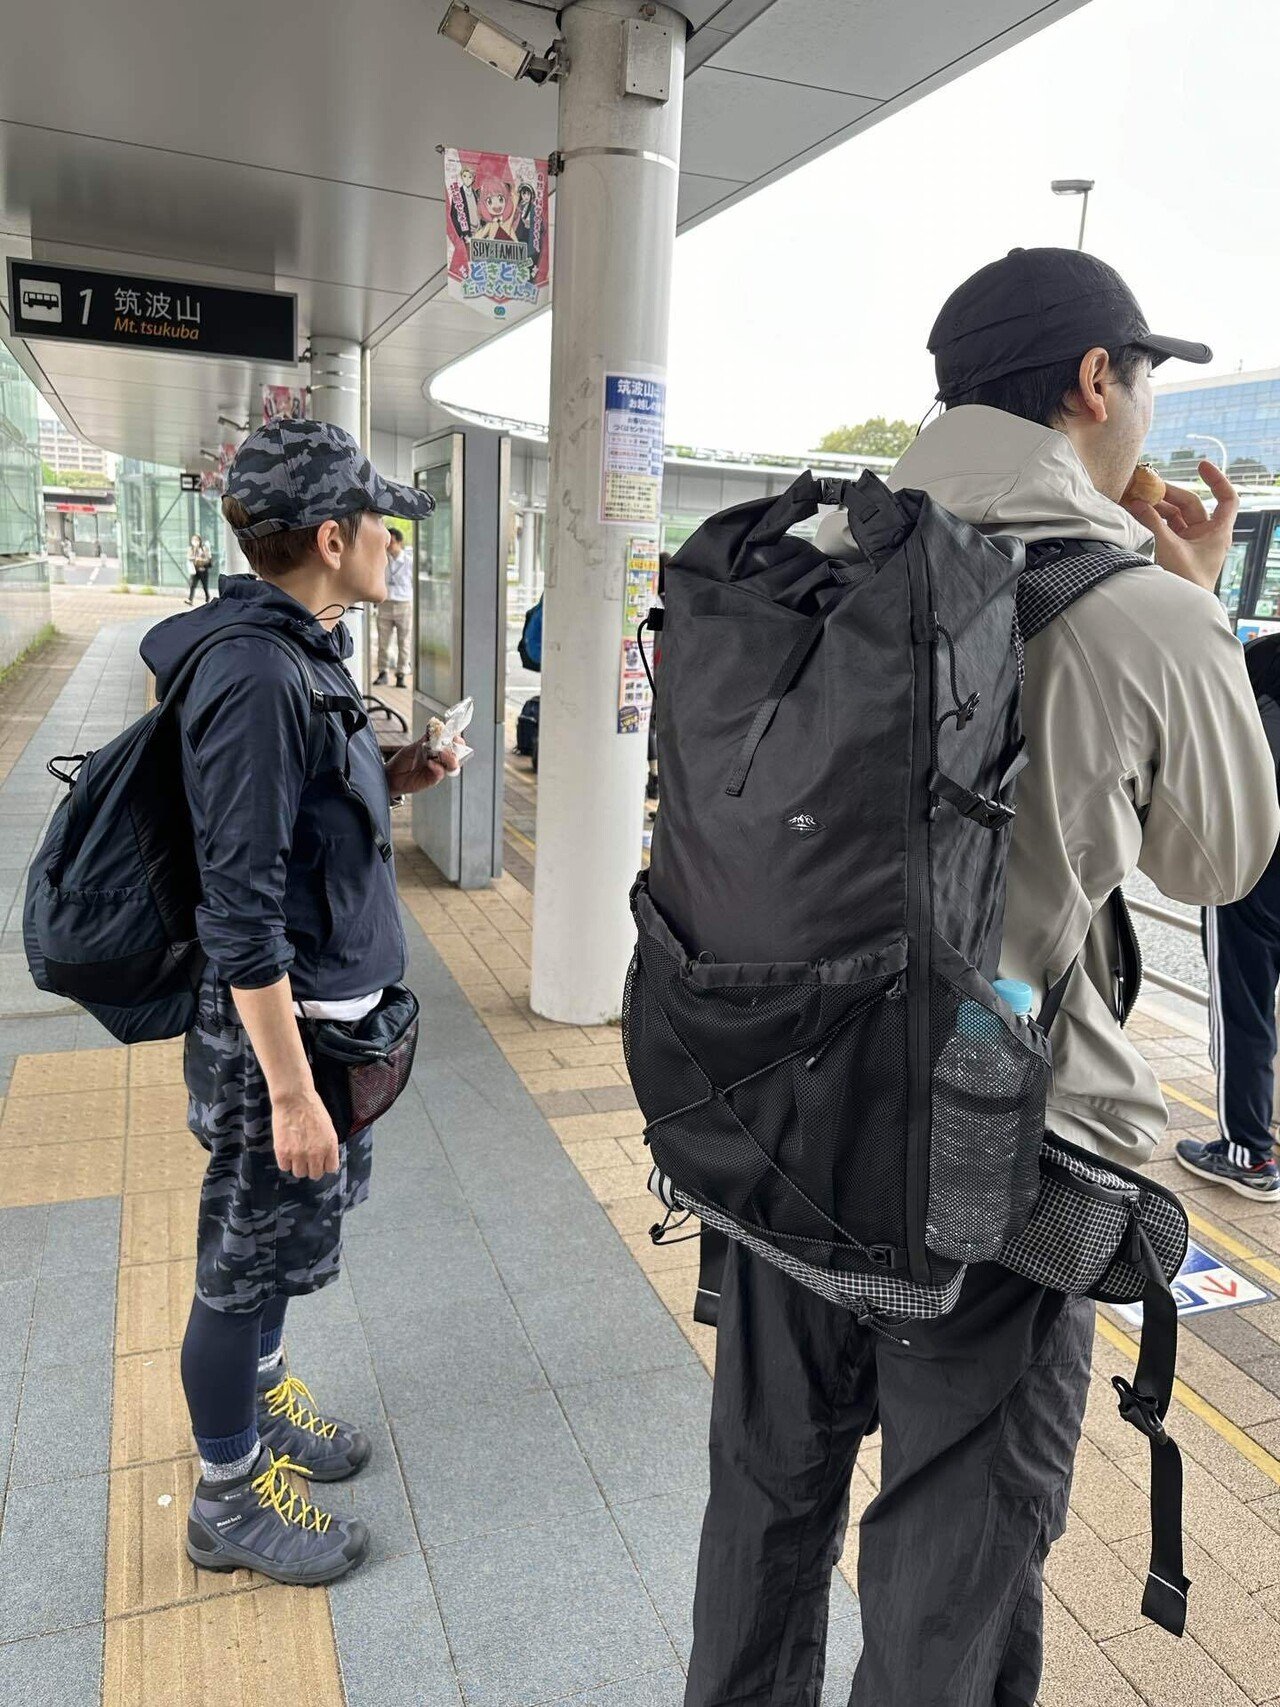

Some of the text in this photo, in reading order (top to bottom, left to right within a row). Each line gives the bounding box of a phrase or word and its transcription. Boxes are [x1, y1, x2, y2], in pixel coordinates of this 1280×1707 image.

[471, 262, 530, 283] どきどき
[79, 287, 200, 325] 1 筑波山
[114, 317, 199, 340] Mt. tsukuba
